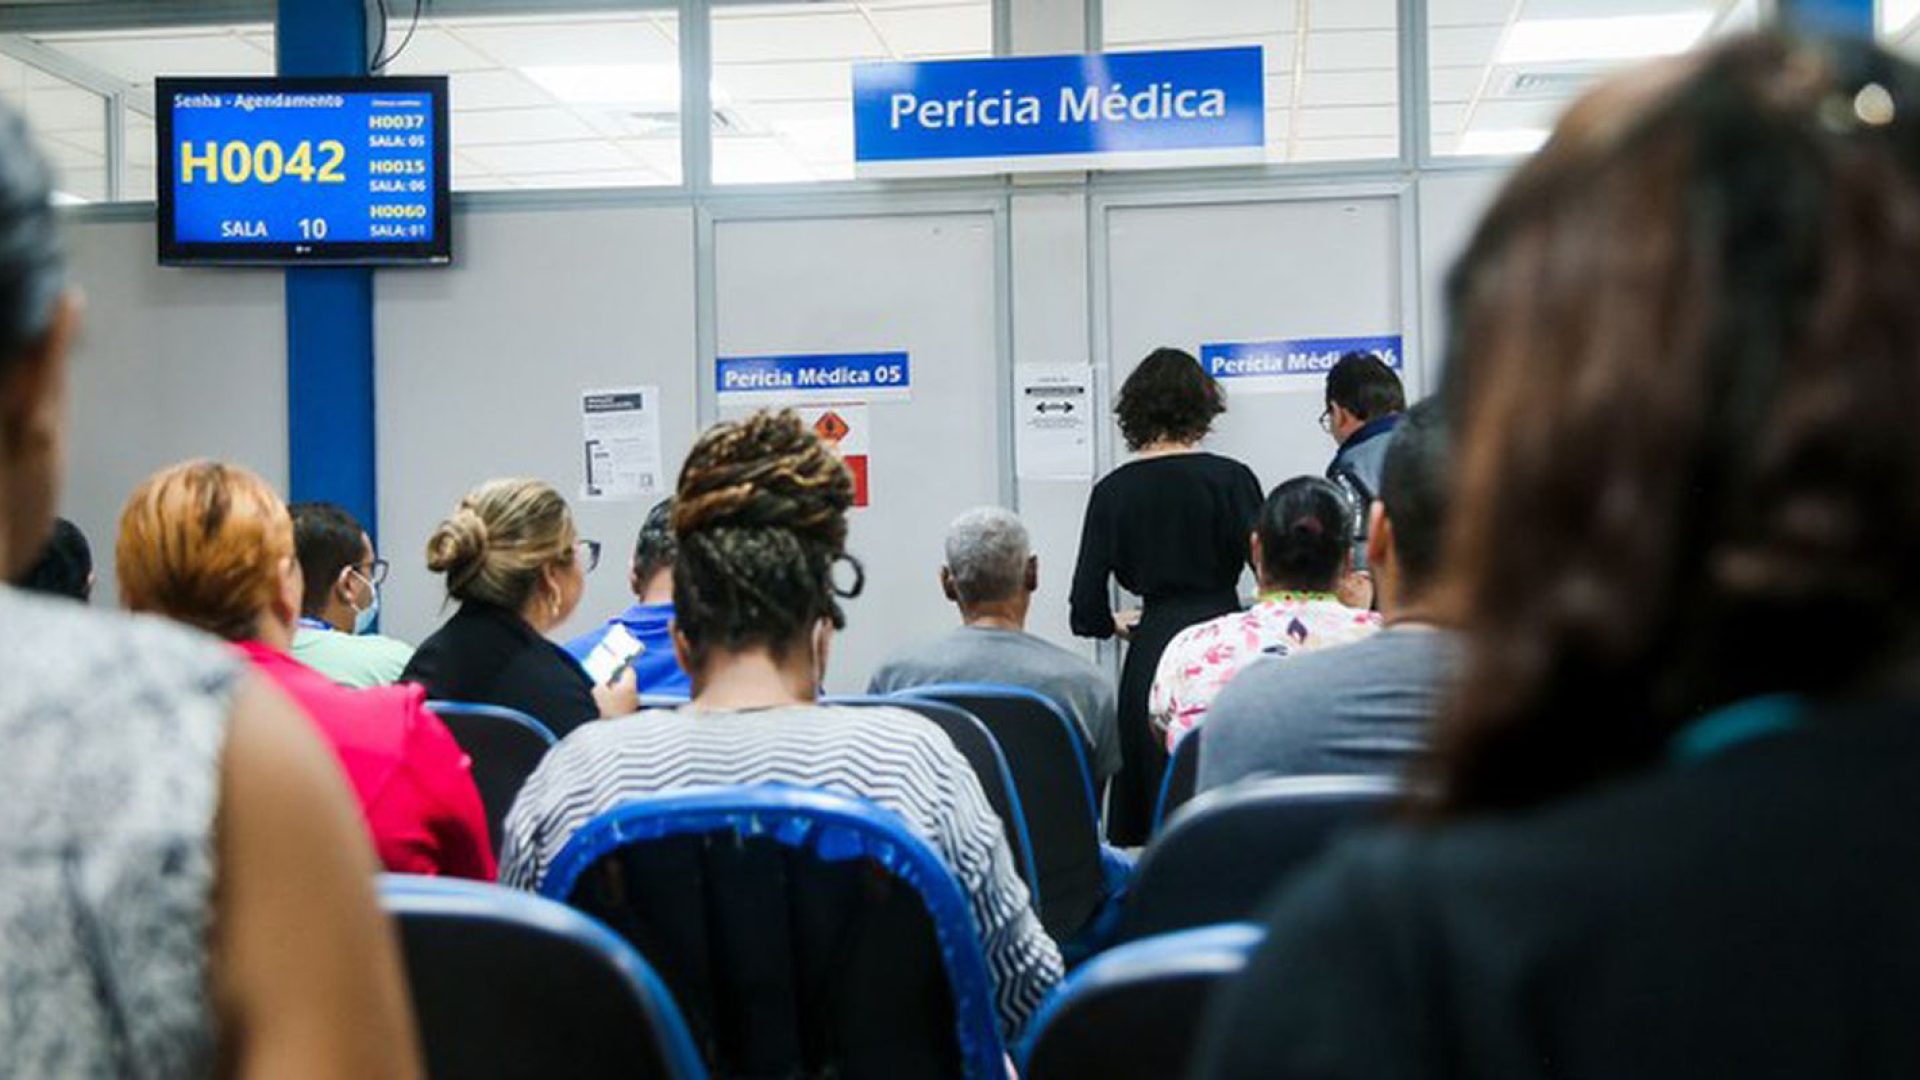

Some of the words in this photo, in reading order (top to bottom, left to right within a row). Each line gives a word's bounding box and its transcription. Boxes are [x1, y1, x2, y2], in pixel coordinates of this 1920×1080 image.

[174, 94, 221, 108] Senha
[234, 94, 344, 112] Agendamento
[889, 90, 1040, 130] Perícia
[1059, 82, 1227, 123] Médica
[369, 115, 425, 130] H0037
[181, 140, 346, 182] H0042
[369, 160, 425, 174] H0015
[221, 220, 268, 238] SALA
[298, 217, 327, 240] 10
[1287, 350, 1342, 370] Médi
[798, 366, 871, 385] Médica
[874, 365, 902, 384] 05
